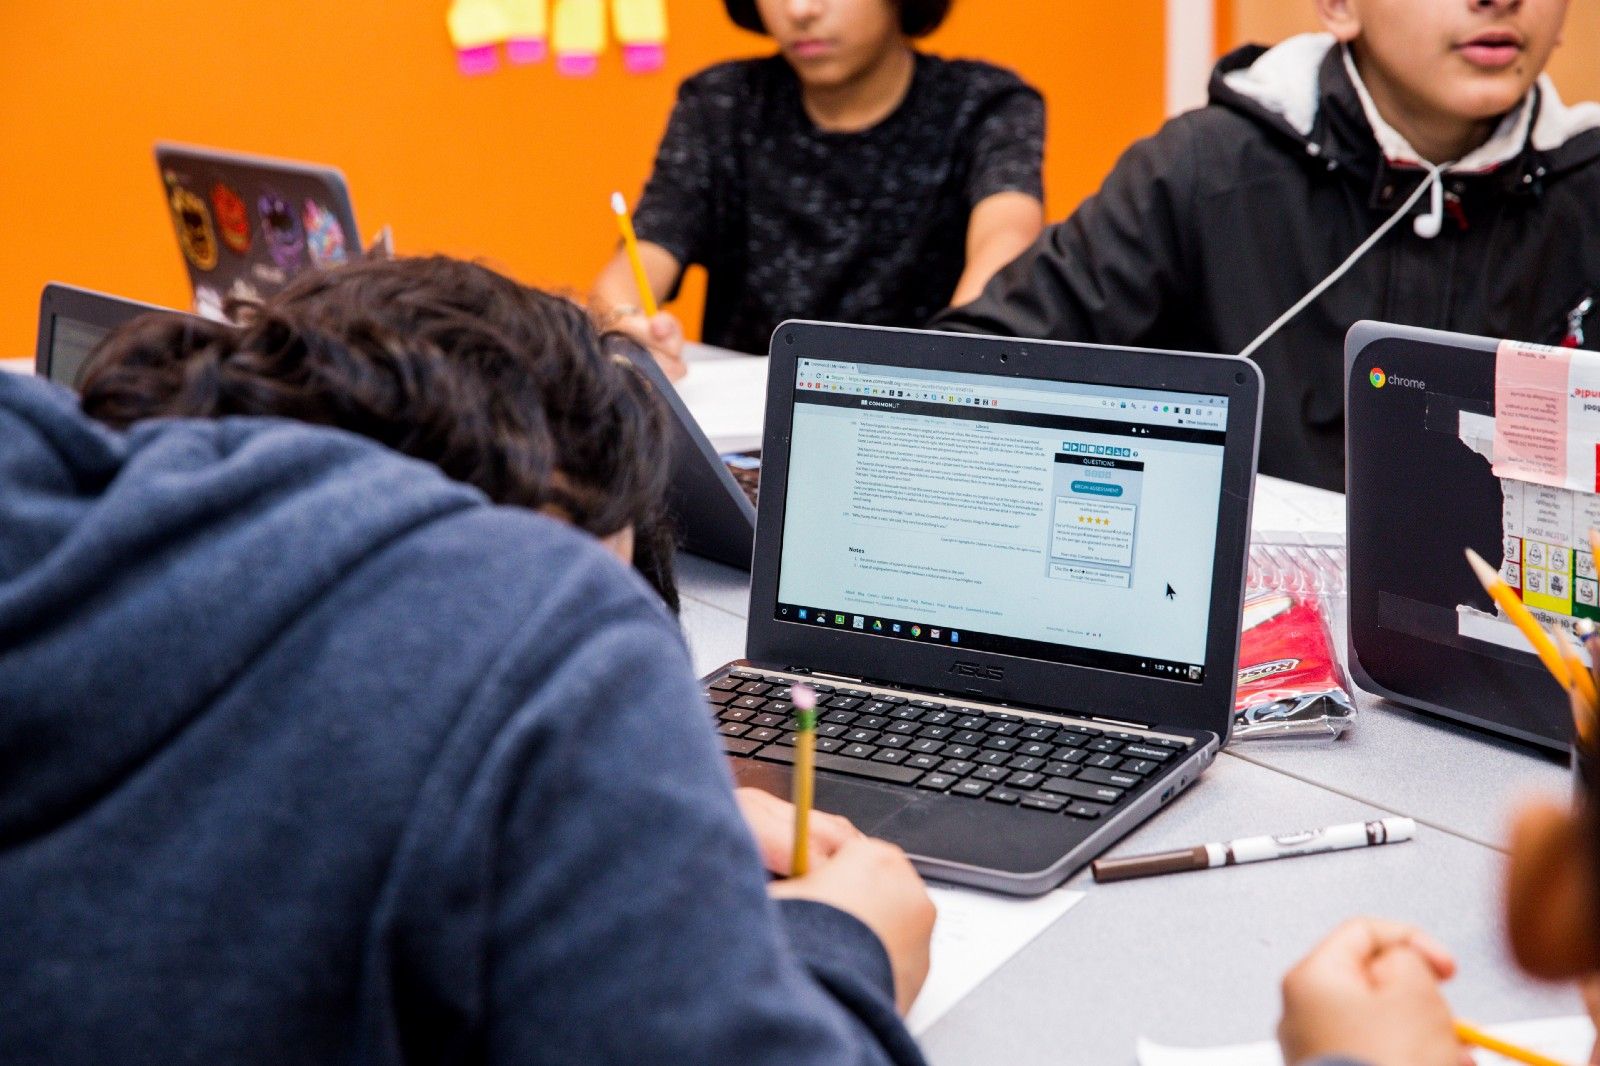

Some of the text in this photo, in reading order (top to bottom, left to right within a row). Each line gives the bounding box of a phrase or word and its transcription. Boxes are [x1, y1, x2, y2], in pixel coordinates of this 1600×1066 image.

[1388, 374, 1425, 390] chrome
[1083, 458, 1115, 467] QUESTIONS
[1527, 528, 1543, 538] ZONE
[945, 660, 1004, 682] ASUS
[1128, 746, 1169, 757] backspace
